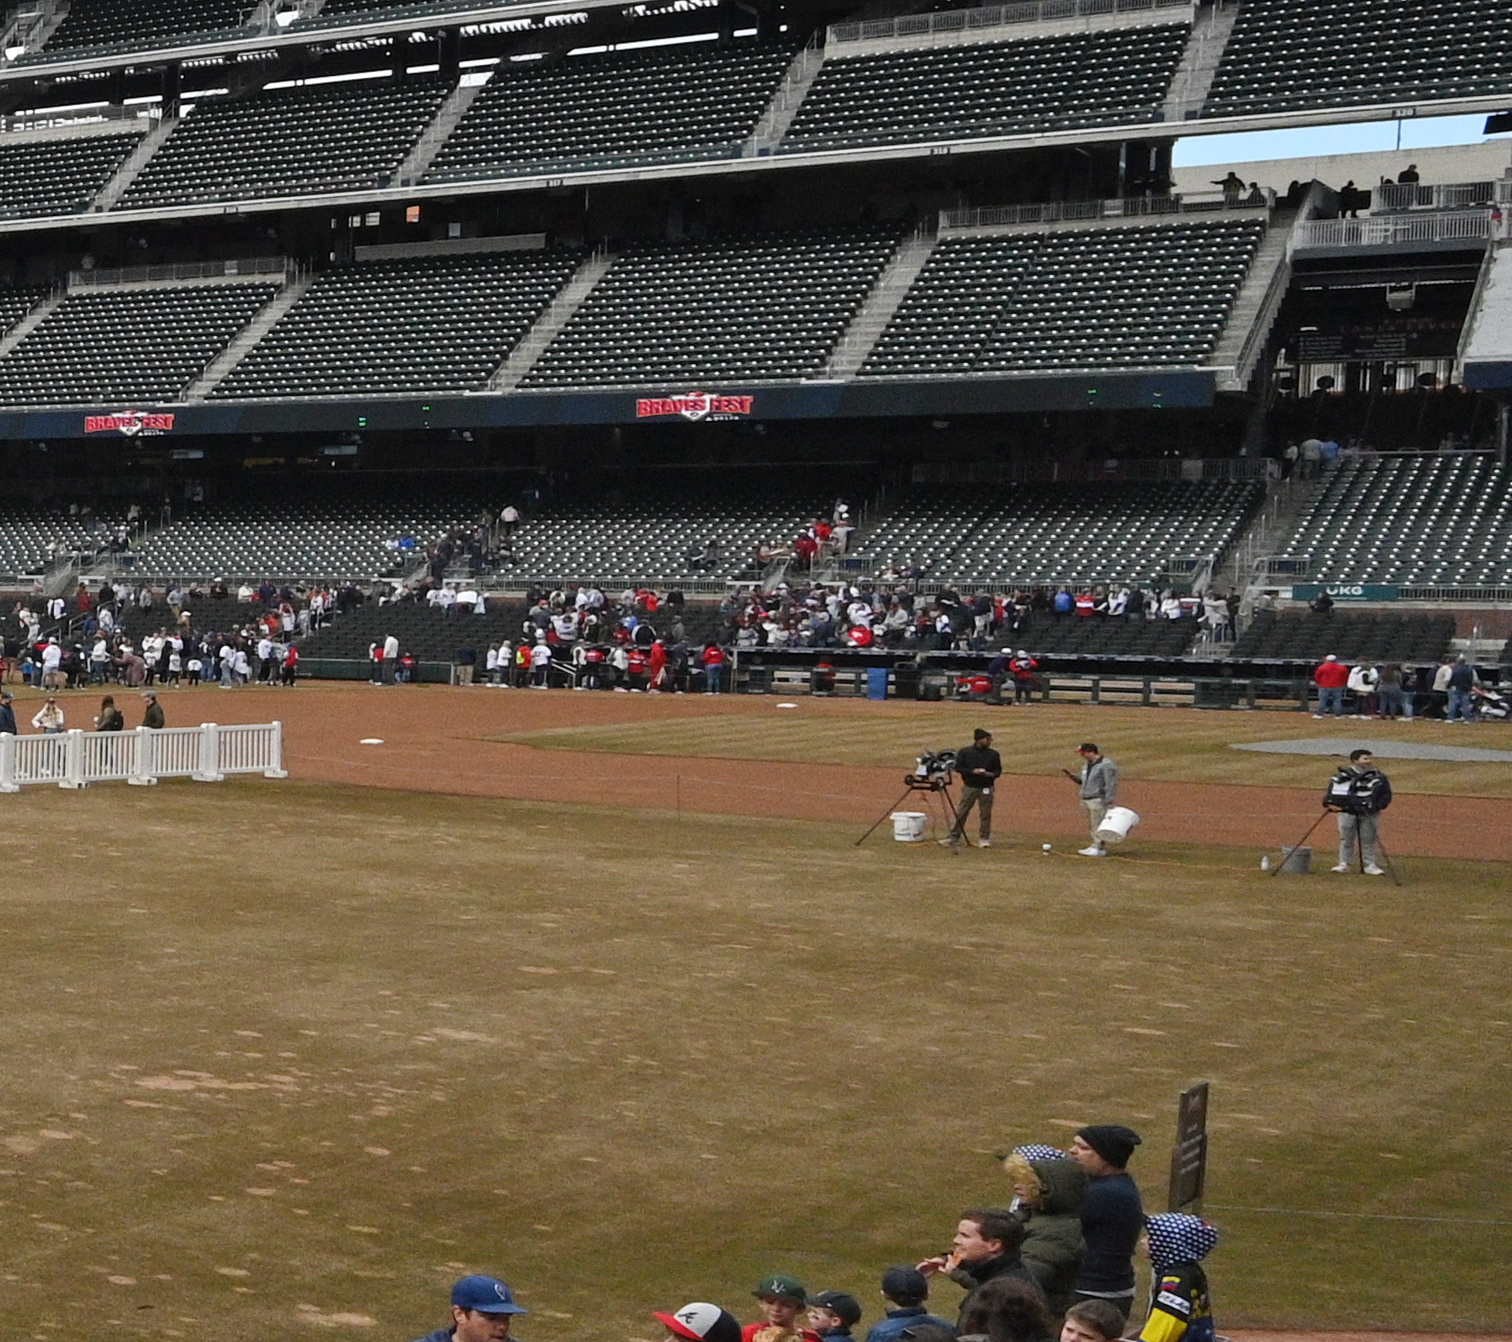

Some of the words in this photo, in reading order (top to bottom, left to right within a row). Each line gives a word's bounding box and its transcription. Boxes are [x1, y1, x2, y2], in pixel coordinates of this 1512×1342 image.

[638, 399, 707, 417] BRAVES
[711, 397, 753, 414] FEST
[1325, 585, 1364, 596] UKG
